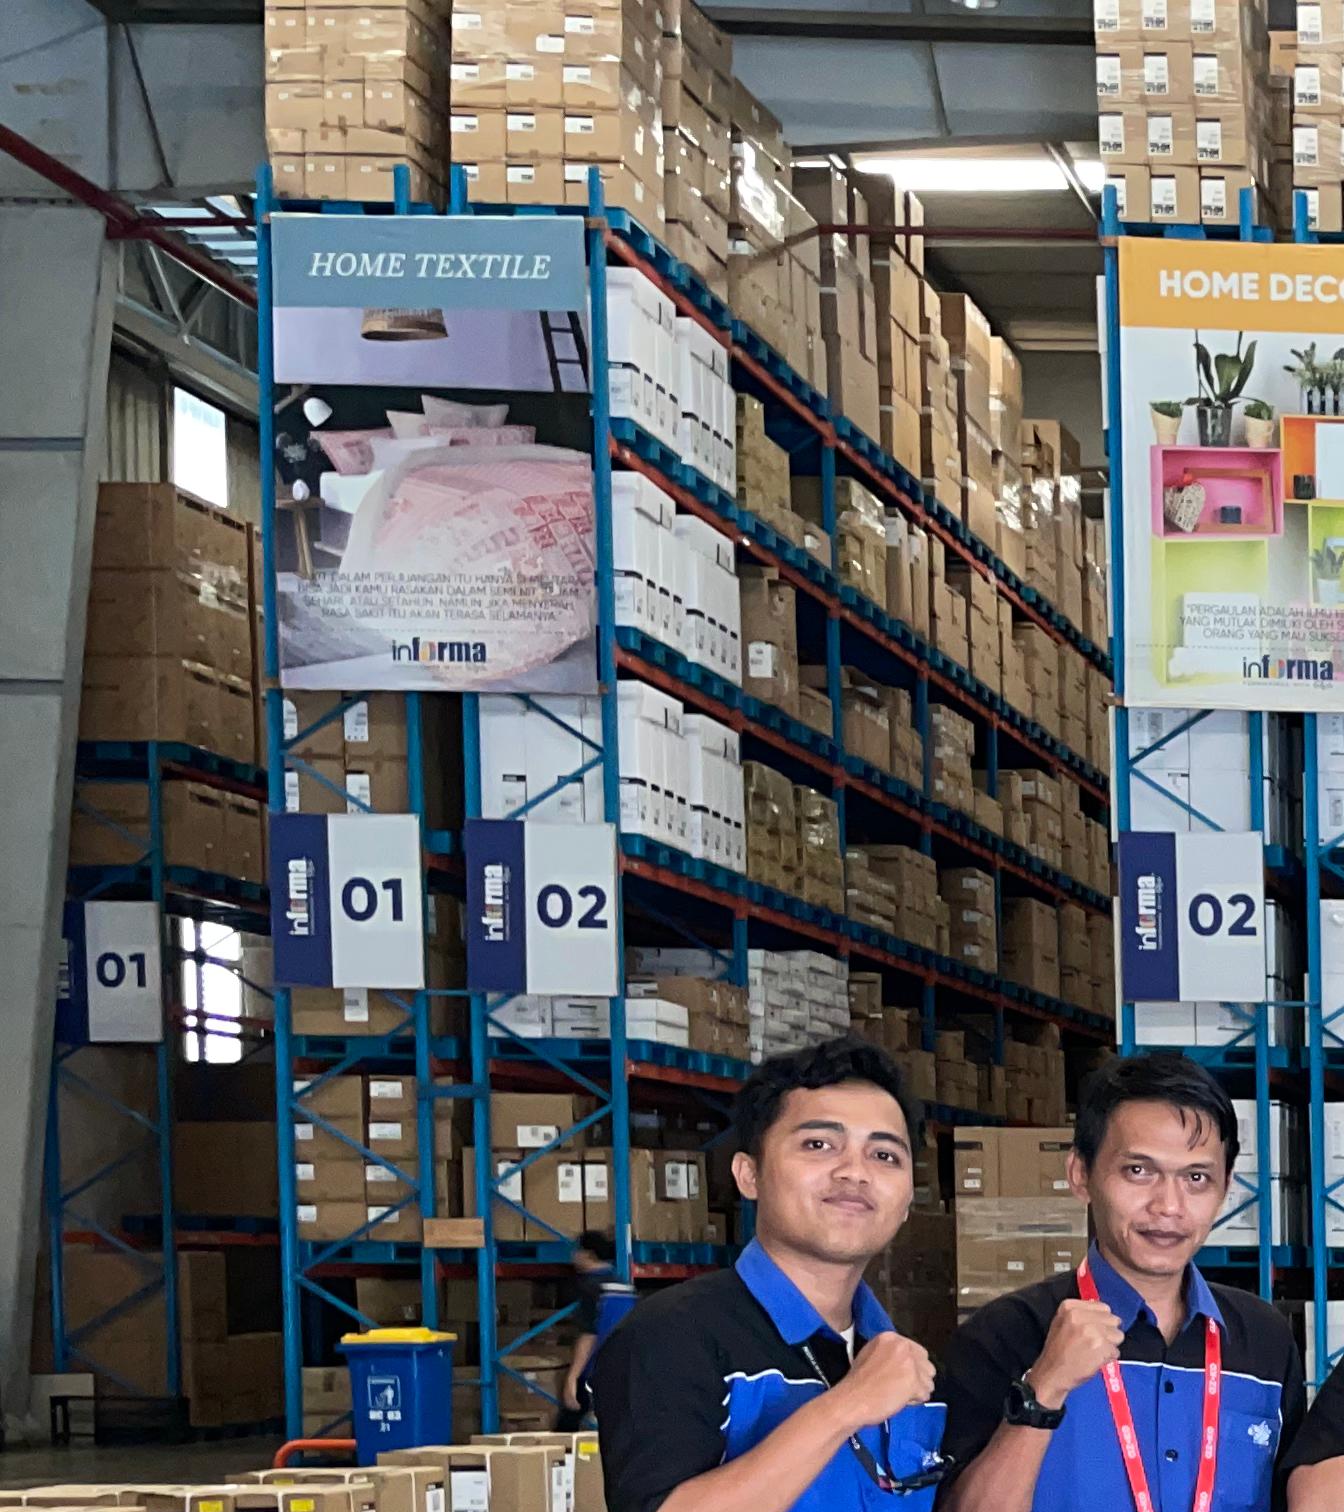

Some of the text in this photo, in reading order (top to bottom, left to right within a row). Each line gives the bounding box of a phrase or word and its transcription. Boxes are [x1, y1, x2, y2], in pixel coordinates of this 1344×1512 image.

[308, 252, 551, 279] HOME TEXTILE
[1159, 269, 1259, 300] HOME
[1213, 616, 1256, 628] MUTLAK
[1304, 618, 1336, 630] OLEH
[1259, 605, 1304, 618] ADALAH
[391, 636, 487, 663] informa
[1202, 627, 1245, 640] ORANG
[1248, 628, 1278, 641] YANG
[1281, 629, 1306, 642] MAU
[1243, 654, 1334, 681] informa
[286, 857, 310, 936] informa
[341, 876, 404, 922] 01
[481, 863, 504, 941] informa
[536, 884, 608, 929] 02
[1135, 874, 1157, 951] informa
[1188, 893, 1257, 936] 02
[96, 952, 147, 988] 01
